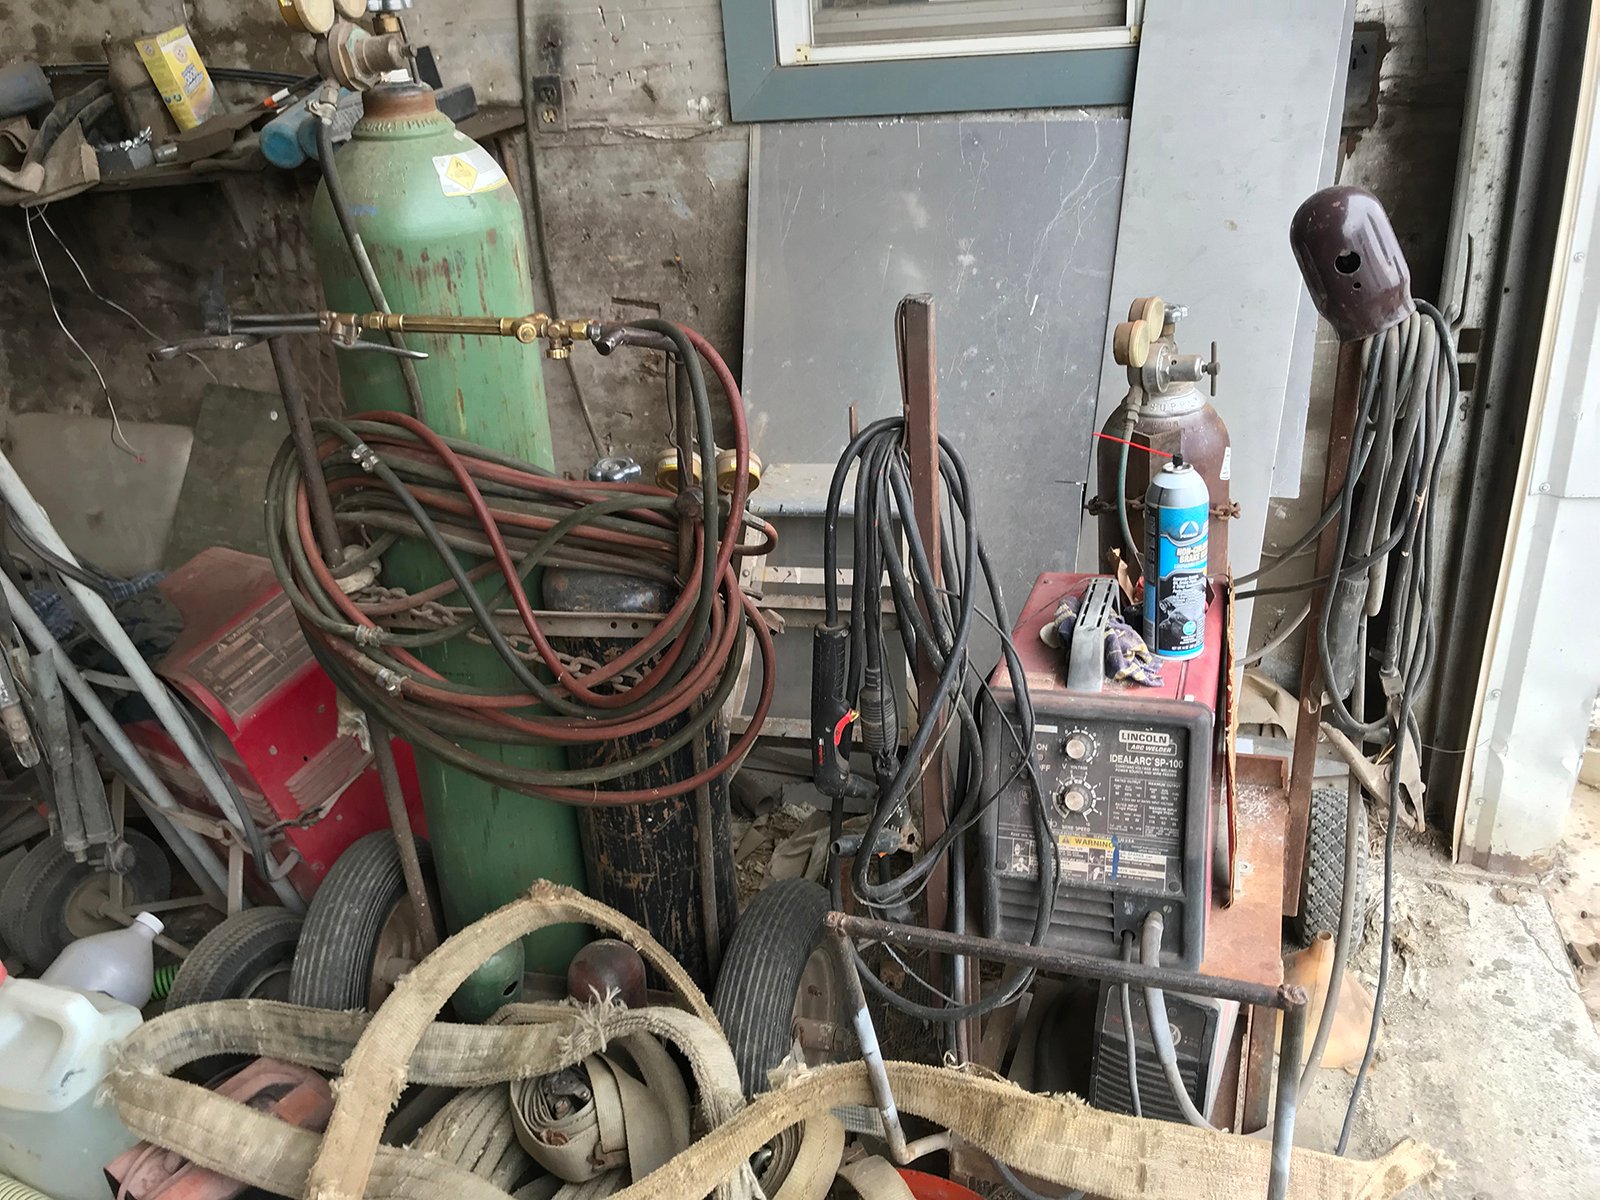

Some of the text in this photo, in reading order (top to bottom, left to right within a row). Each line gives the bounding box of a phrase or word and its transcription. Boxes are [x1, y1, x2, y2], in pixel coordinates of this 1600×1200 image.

[1121, 732, 1167, 744] LINCOLN
[1036, 743, 1048, 751] ON
[1145, 745, 1172, 753] WELDER
[1109, 754, 1184, 769] IDEALARC SP-100
[1039, 764, 1051, 772] FF
